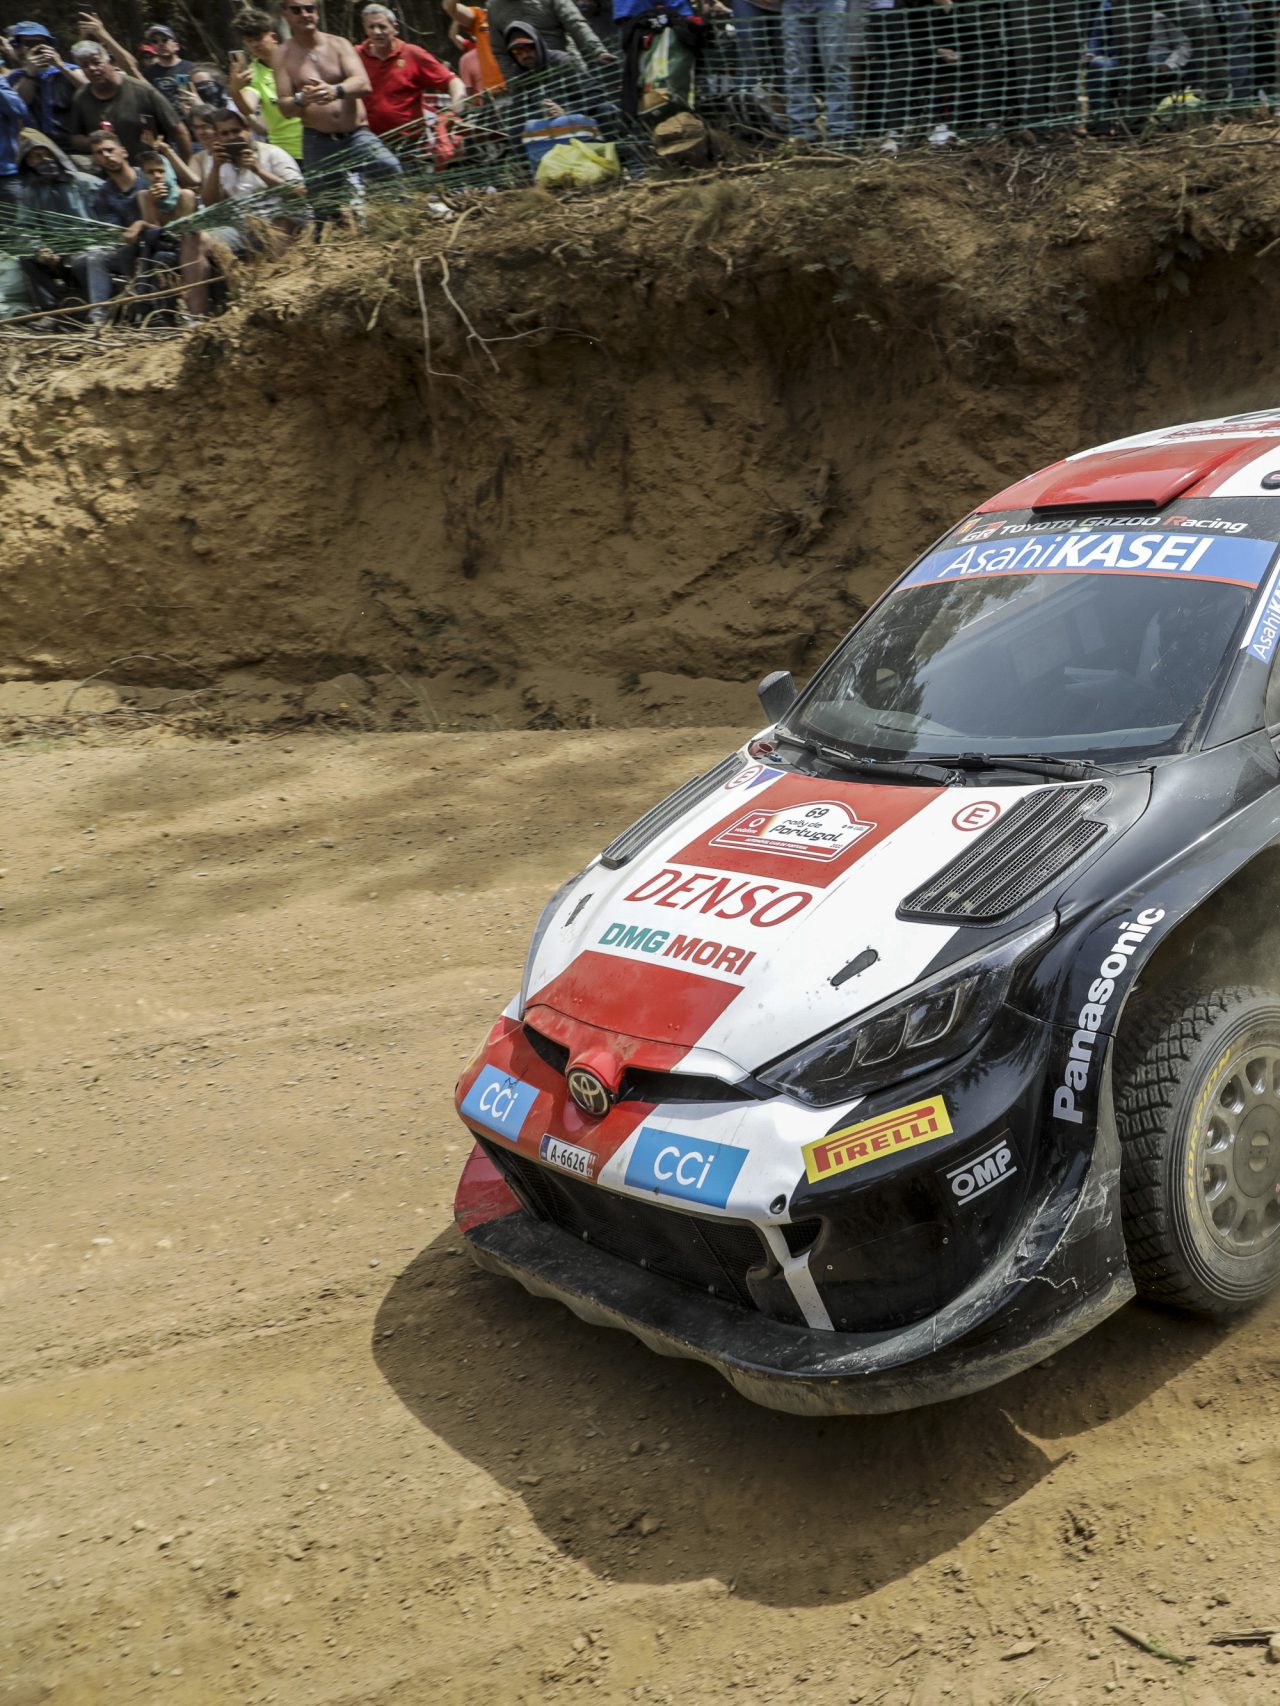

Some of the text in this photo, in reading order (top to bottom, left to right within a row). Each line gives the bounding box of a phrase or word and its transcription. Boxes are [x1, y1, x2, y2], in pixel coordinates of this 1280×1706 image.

[999, 519, 1077, 535] TOYOTA
[1078, 516, 1161, 527] GAZOO
[1163, 515, 1248, 533] Racing
[805, 807, 829, 818] 69
[623, 869, 813, 927] DENSO
[598, 922, 757, 975] DMG MORI
[1052, 908, 1165, 1124] Panasonic
[550, 1144, 586, 1173] A-6626
[812, 1105, 938, 1173] PIRELLI
[951, 1147, 1012, 1197] OMP
